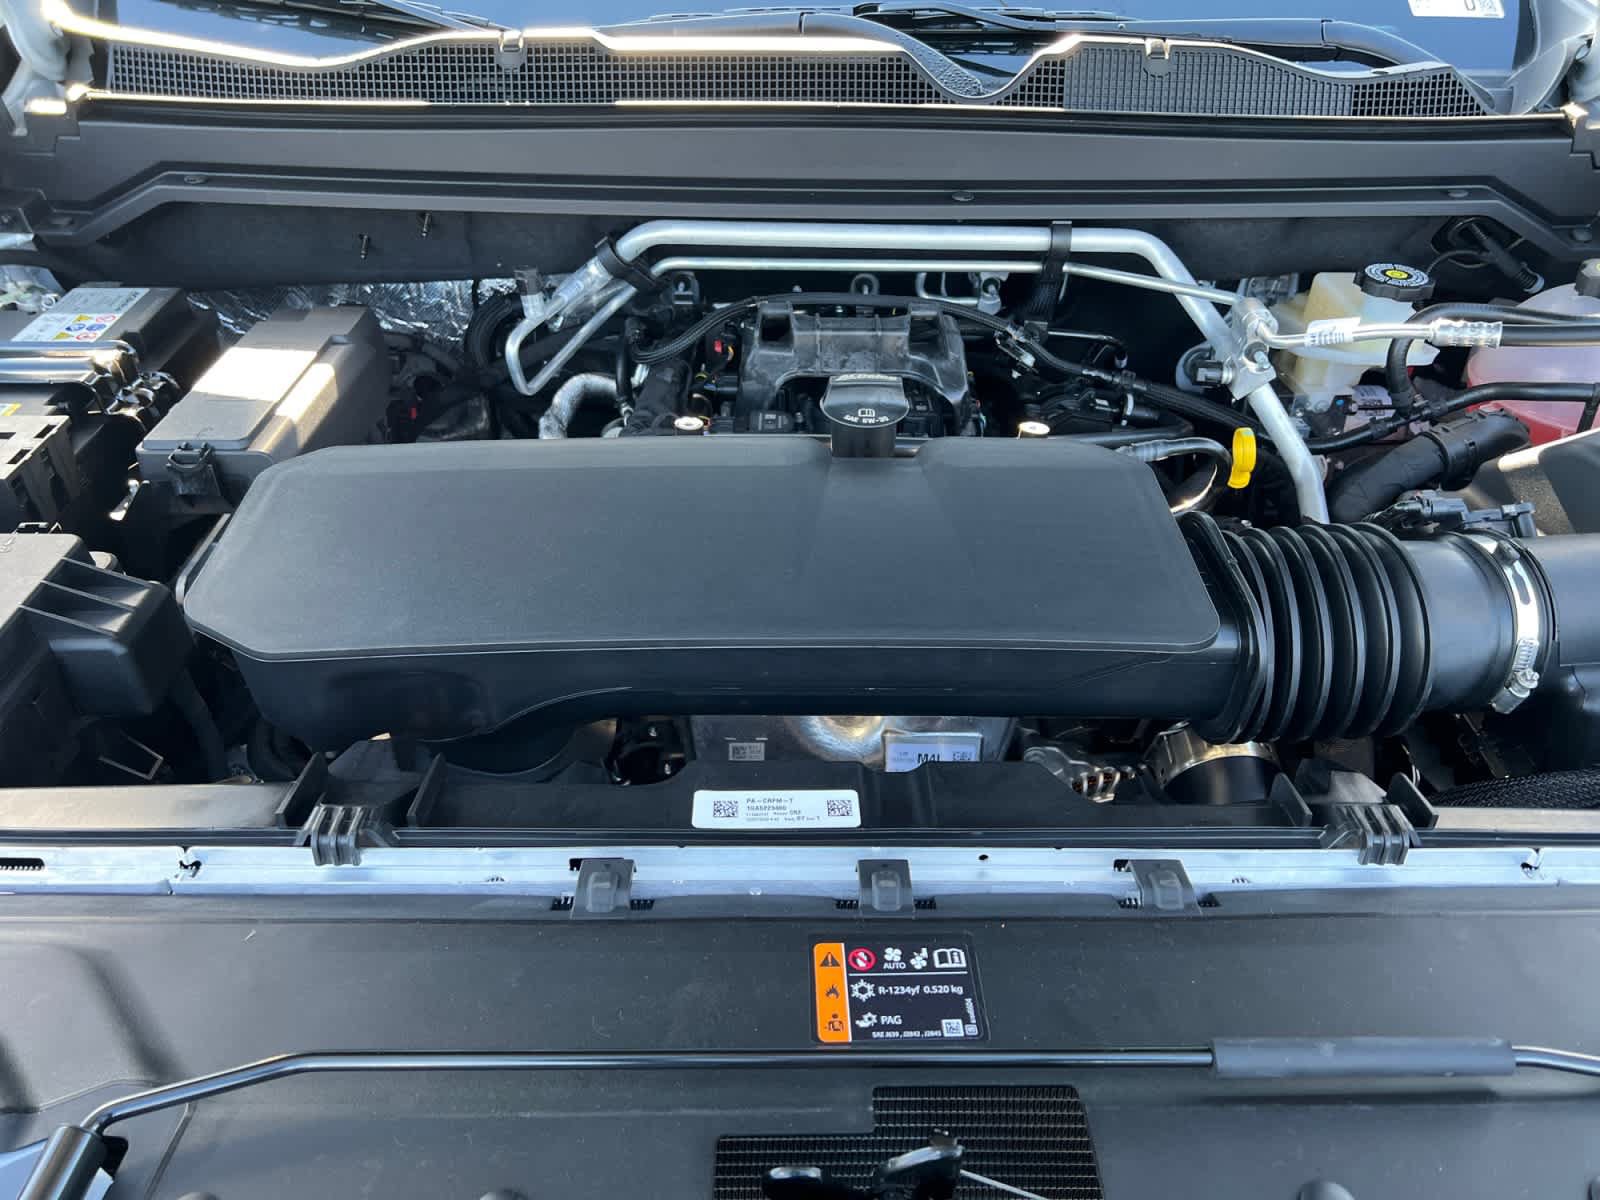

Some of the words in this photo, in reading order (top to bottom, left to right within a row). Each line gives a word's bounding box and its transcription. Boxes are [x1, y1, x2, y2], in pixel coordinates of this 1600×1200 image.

[883, 962, 907, 970] AUTO
[878, 985, 921, 996] R-1234yf
[923, 985, 949, 995] 0.520
[951, 985, 964, 996] kg
[880, 1015, 903, 1025] PAG
